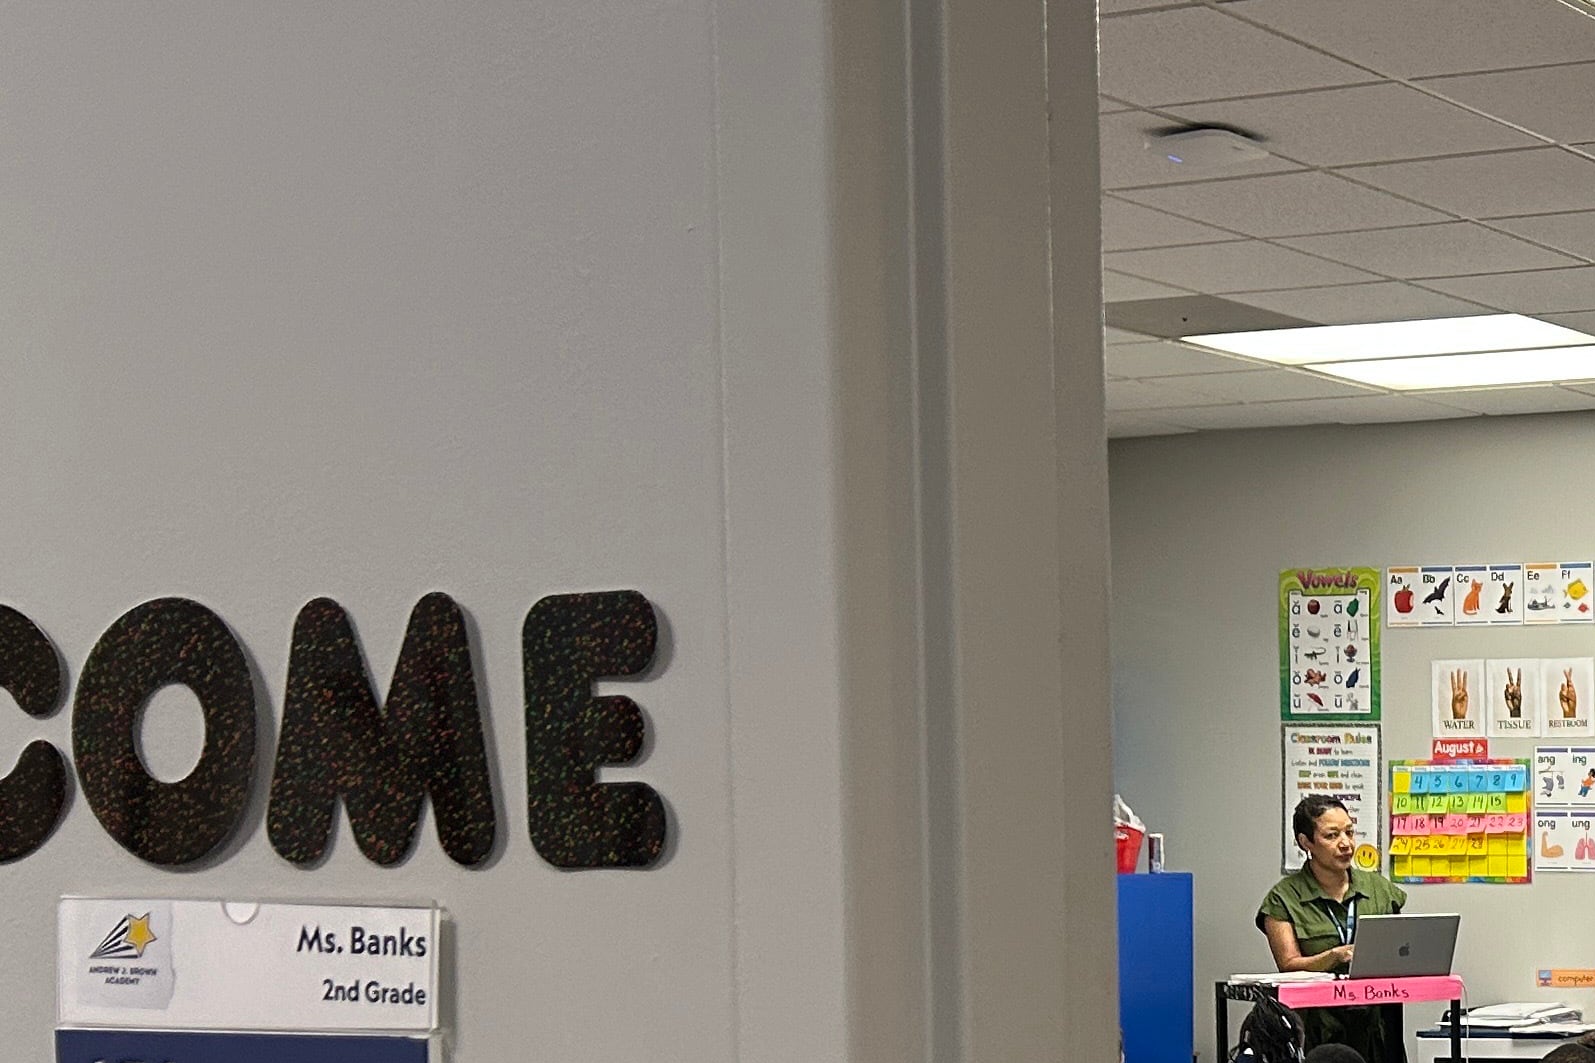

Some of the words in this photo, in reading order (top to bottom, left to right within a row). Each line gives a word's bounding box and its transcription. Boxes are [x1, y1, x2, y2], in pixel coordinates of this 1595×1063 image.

[1297, 570, 1359, 589] Vowels
[1390, 575, 1403, 585] Aa
[1456, 573, 1470, 583] Cc
[1491, 571, 1505, 582] Dd
[1527, 570, 1540, 581] Ee
[1561, 569, 1571, 580] Ff
[1443, 720, 1475, 730] WATER
[1497, 720, 1531, 729] TISSUE
[1548, 719, 1588, 728] RESTROOM
[1434, 741, 1474, 757] August
[1537, 755, 1556, 765] ang
[1572, 754, 1587, 766] ing
[1415, 776, 1423, 789] 4
[1434, 775, 1442, 787] 5
[1454, 776, 1463, 787] 6
[1476, 775, 1483, 788] 7
[1493, 775, 1501, 786] 8
[1511, 773, 1517, 785] 9
[1396, 797, 1407, 808] 10
[1415, 795, 1424, 810] 11
[1431, 797, 1442, 807] 12
[1452, 797, 1464, 808] 13
[1473, 796, 1483, 809] 14
[1490, 793, 1502, 806] 15
[1397, 819, 1407, 830] 17
[1415, 818, 1425, 829] 18
[1434, 817, 1444, 828] 19
[1450, 820, 1463, 830] 20
[1470, 819, 1480, 829] 21
[1489, 818, 1503, 827] 22
[1508, 818, 1523, 827] 23
[1537, 820, 1556, 830] ong
[1572, 820, 1590, 830] ung
[1415, 840, 1430, 850] 25
[1433, 839, 1445, 849] 26
[297, 925, 343, 953] Ms.
[351, 926, 426, 957] Banks
[105, 976, 140, 985] ACADEMY
[1558, 975, 1594, 987] computer
[322, 978, 360, 1001] 2nd
[365, 980, 426, 1005] Grade
[1364, 983, 1410, 1000] Banks
